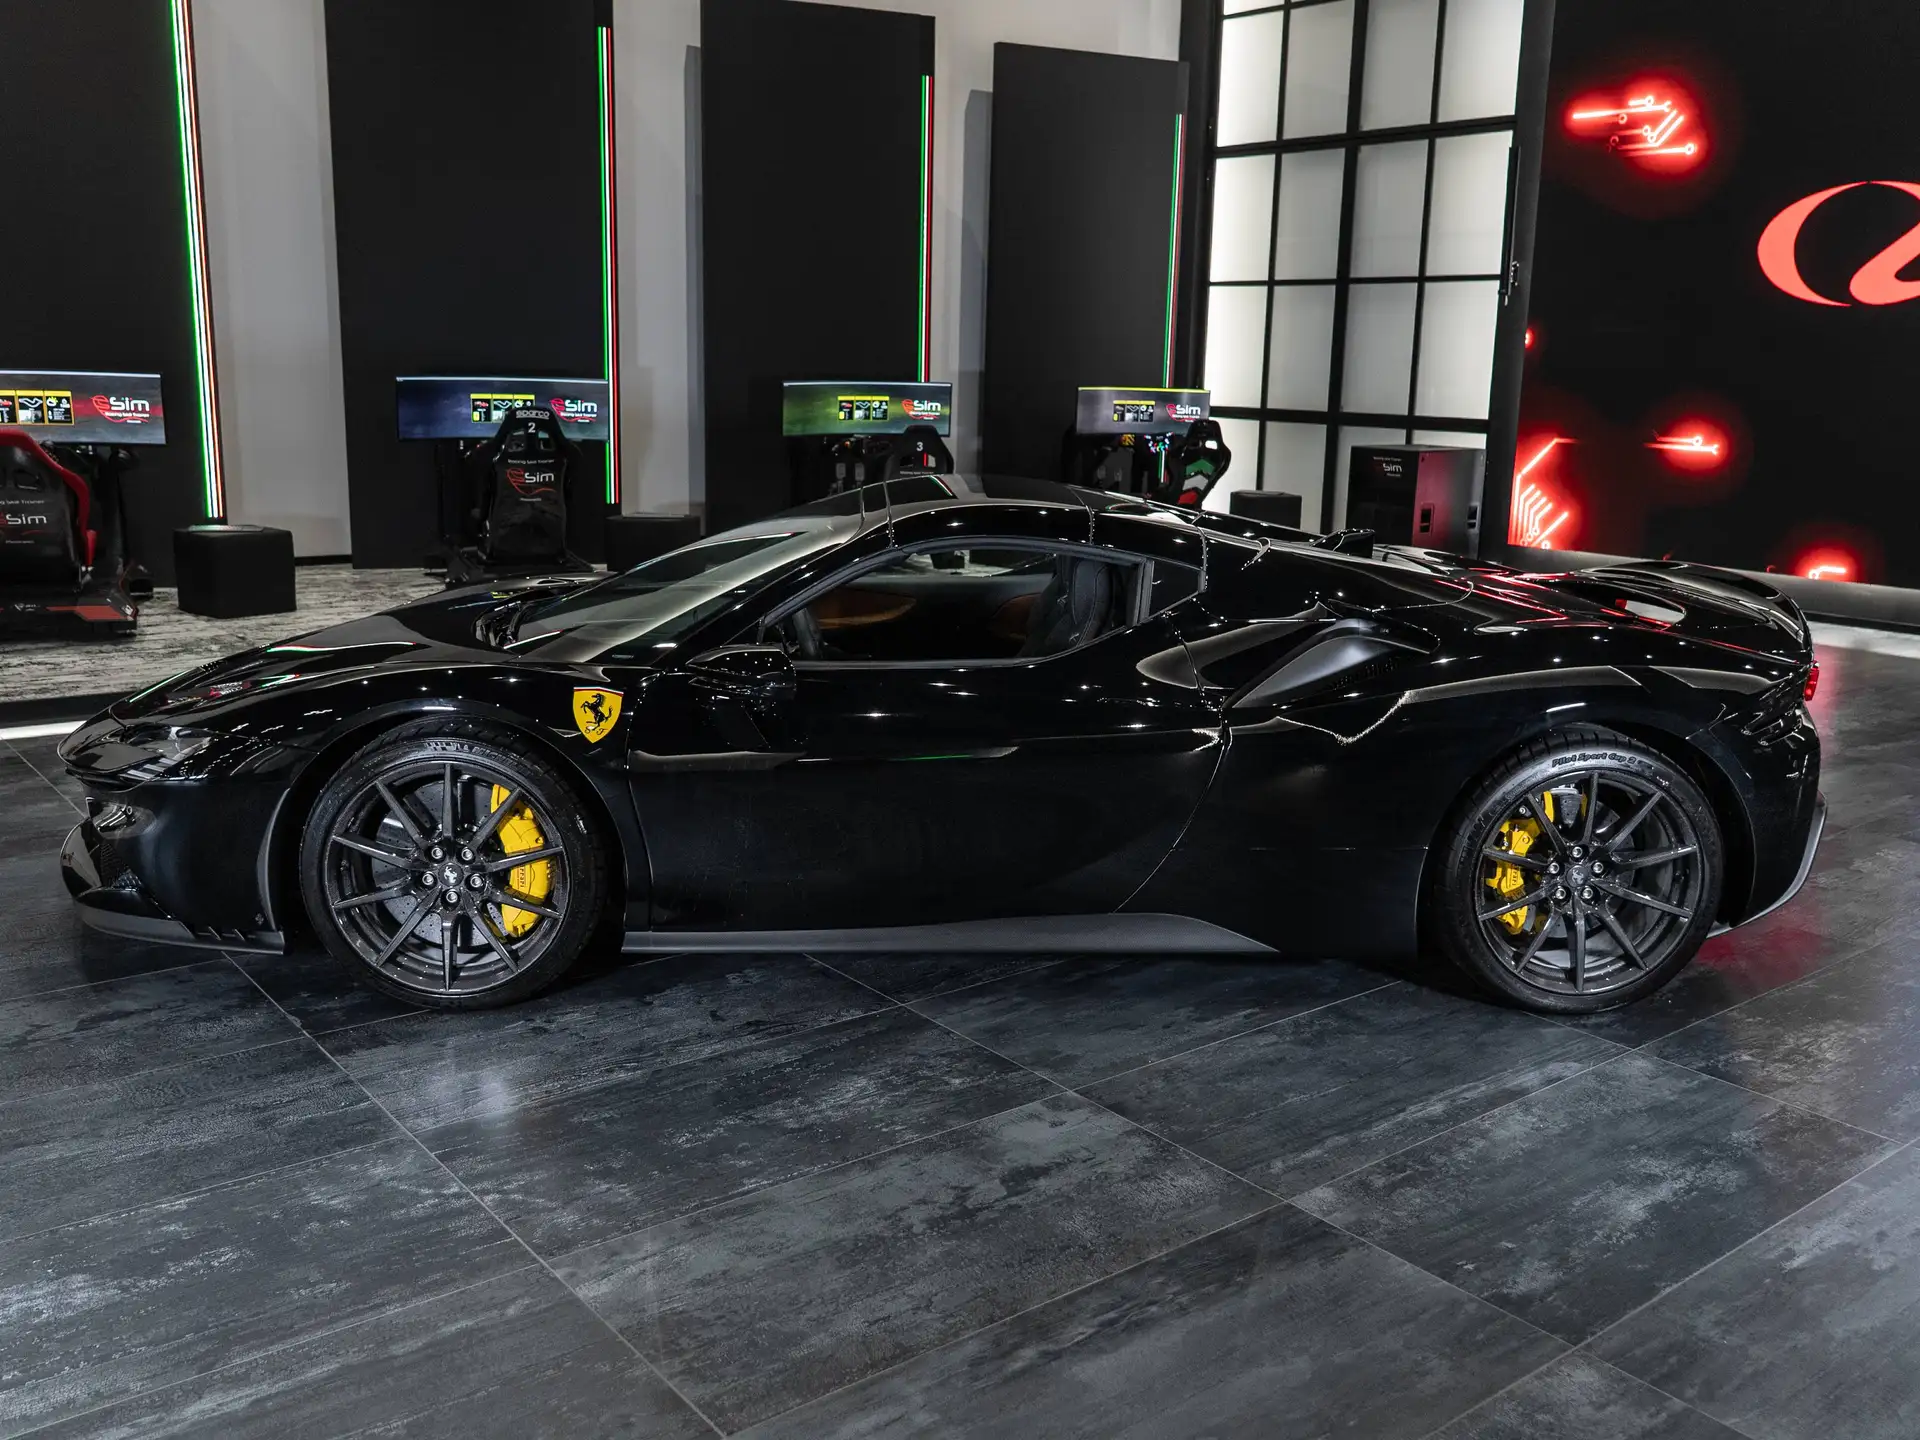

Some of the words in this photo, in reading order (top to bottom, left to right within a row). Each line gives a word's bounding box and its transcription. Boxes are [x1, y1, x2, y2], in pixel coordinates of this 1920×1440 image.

[528, 422, 536, 433] 2
[916, 441, 924, 451] 3
[1551, 755, 1577, 767] Pilot
[1577, 752, 1608, 762] Sport
[1608, 753, 1627, 764] Cup
[1626, 756, 1637, 764] 2
